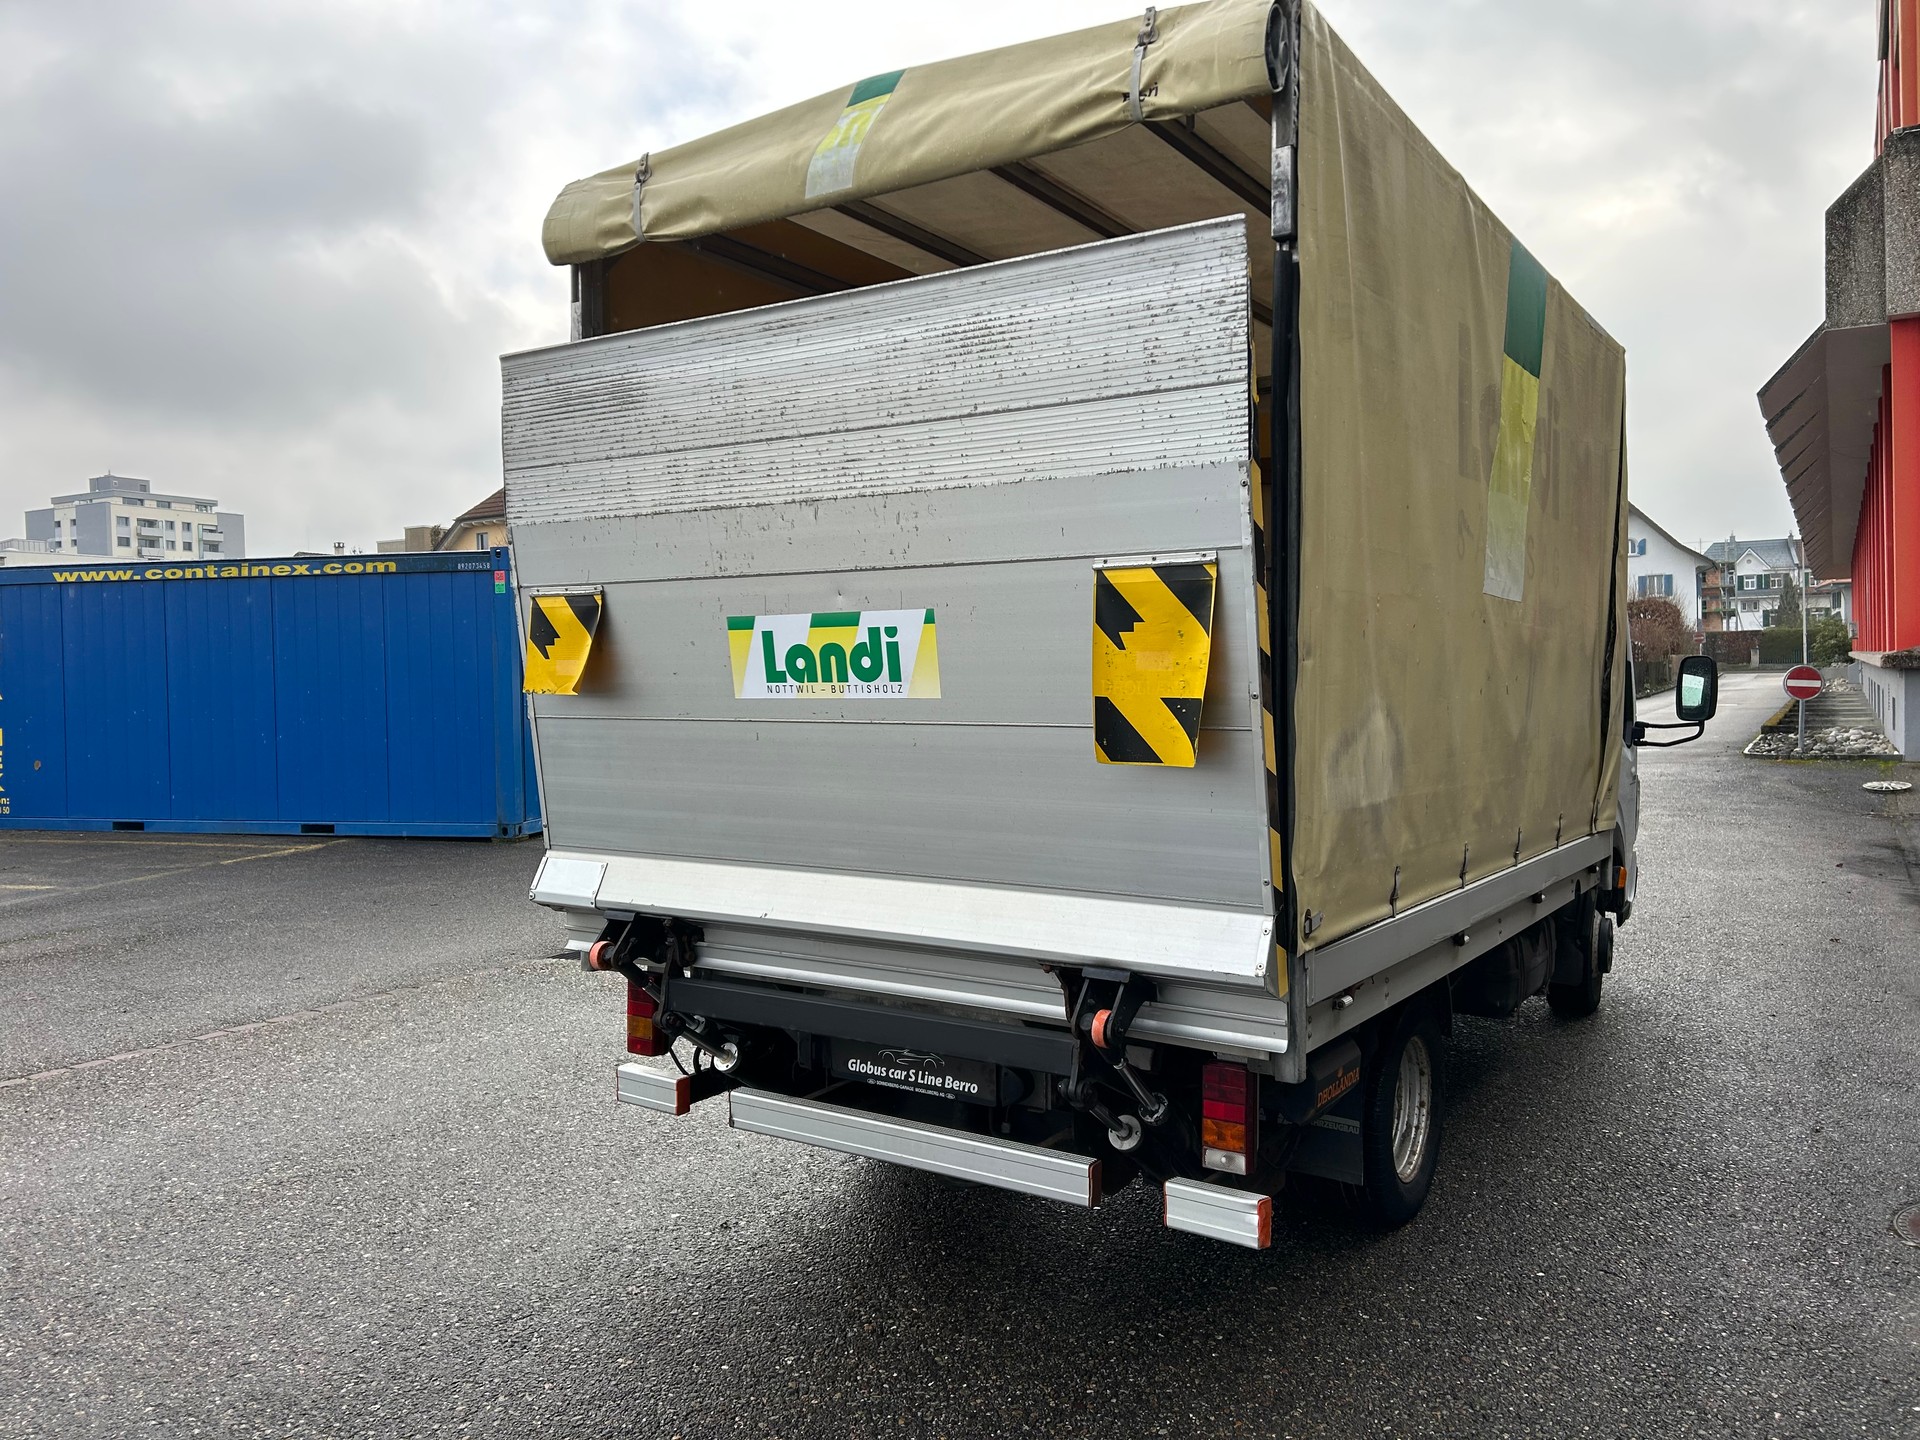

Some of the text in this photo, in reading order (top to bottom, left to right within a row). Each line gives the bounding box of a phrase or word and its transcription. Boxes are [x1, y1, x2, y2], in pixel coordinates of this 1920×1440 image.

[52, 560, 397, 583] www.containex.com
[761, 626, 903, 683] Landi
[767, 684, 816, 694] NOTTWIL
[831, 684, 903, 694] BUTTISHOLZ
[847, 1058, 979, 1094] Globus car S Line Berro
[1317, 1067, 1360, 1108] DHOLLANDIA
[1310, 1120, 1360, 1135] HRZEUGBAU
